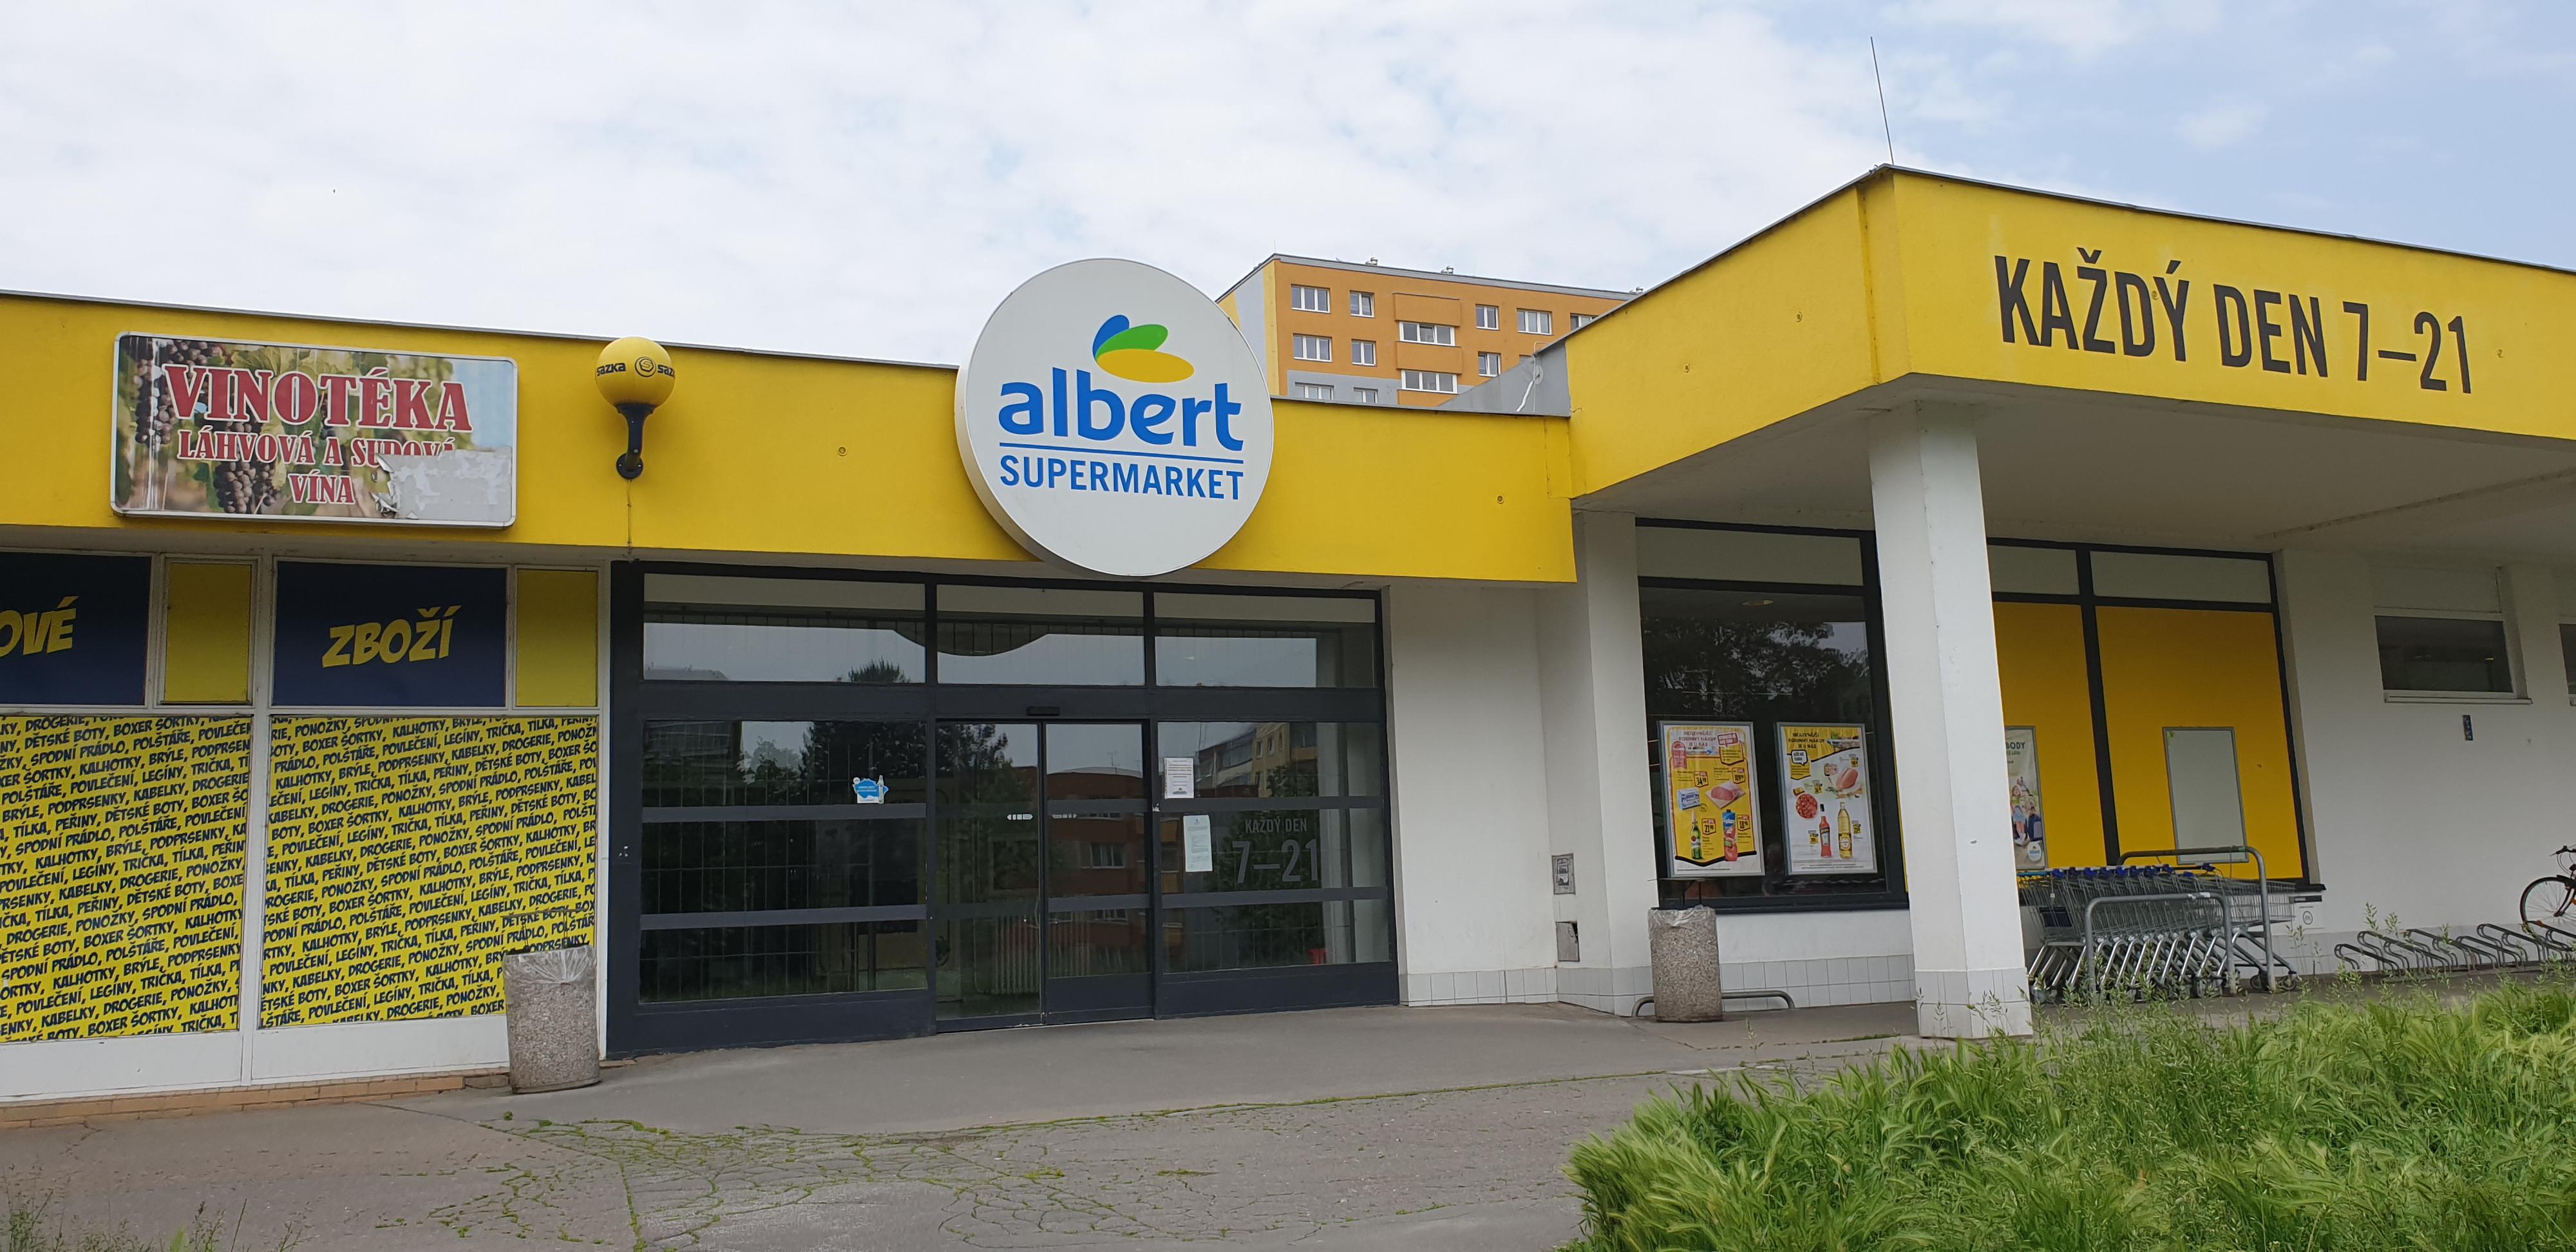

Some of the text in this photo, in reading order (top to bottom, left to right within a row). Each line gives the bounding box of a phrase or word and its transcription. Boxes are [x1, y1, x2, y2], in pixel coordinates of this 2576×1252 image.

[1994, 247, 2190, 362] KAŽDÝ
[2213, 284, 2329, 377] DEN
[162, 364, 473, 432] VINOTÉKA
[998, 367, 1244, 451] albert
[178, 425, 314, 464] LÁHVOVÁ
[323, 437, 345, 466] A
[289, 470, 356, 504] VÍNA
[1000, 455, 1244, 500] SUPERMARKET
[321, 605, 462, 668] ZBOŽÍ
[24, 719, 153, 750] DĚTSKÉ BOTY, BOXER
[30, 730, 194, 766] SPODNÍ PRÁDLO, POLŠTÁŘE,
[274, 755, 319, 773] PRÁDLO,
[323, 745, 379, 766] POLŠTÁŘE,
[382, 736, 441, 756] POVLEČENÍ,
[444, 730, 483, 746] LEGÍNY,
[486, 723, 525, 739] TRIČKA,
[1, 757, 234, 805] POLŠTÁŘE, POVLEČENÍ, LEGÍNY, TRIČKA,
[23, 748, 188, 784] ŠORTKY, KALHOTKY, BRÝLE,
[276, 733, 554, 790] KALHOTKY, BRÝLE, PODPRSENKY, KABELKY, DROGERIE,
[309, 743, 581, 801] LEGÍNY, TRIČKA, TÍLKA, PEŘINY, DĚTSKÉ BOTY, BOXER
[2, 804, 44, 823] BRÝLE,
[48, 792, 130, 815] PODPRSENKY,
[133, 782, 189, 802] KABELKY,
[13, 792, 229, 839] TÍLKA, PEŘINY, DĚTSKÉ BOTY, BOXER
[272, 779, 563, 841] BOTY, BOXER ŠORTKY, KALHOTKY, BRÝLE, PODPRSENKY,
[282, 792, 580, 855] POVLEČENÍ, LEGÍNY, TRIČKA, TÍLKA, PEŘINY, DĚTSKÉ BOTY,
[1245, 816, 1307, 833] KAŽDÝ DEN
[15, 817, 181, 856] SPODNÍ PRÁDLO, POLŠTÁŘE,
[35, 826, 229, 869] KALHOTKY, BRÝLE, PODPRSENKY,
[284, 823, 580, 889] TÍLKA, PEŘINY, DĚTSKÉ BOTY, BOXER ŠORTKY, KALHOTKY,
[59, 868, 182, 901] KABELKY, DROGERIE,
[72, 862, 118, 881] LEGÍNY,
[122, 853, 168, 871] TRIČKA,
[172, 846, 208, 863] TÍLKA,
[292, 854, 583, 921] BOTY, BOXER ŠORTKY, KALHOTKY, BRÝLE, PODPRSENKY,
[321, 839, 582, 898] PONOŽKY, SPODNÍ PRÁDLO, POLŠTÁŘE, POVLEČENÍ,
[6, 891, 238, 945] DROGERIE, PONOŽKY, SPODNÍ PRÁDLO,
[35, 880, 209, 922] TÍLKA, PEŘINY, DĚTSKÉ BOTY,
[301, 869, 585, 936] PRÁDLO, POLŠTÁŘE, POVLEČENÍ, LEGÍNY, TRIČKA, TÍLKA,
[1, 925, 239, 981] SPODNÍ PRÁDLO, POLŠTÁŘE, POVLEČENÍ,
[43, 920, 178, 956] BOTY, BOXER ŠORTKY,
[292, 934, 504, 989] KABELKY, DROGERIE, PONOŽKY, SPODNÍ
[16, 962, 226, 1015] POVLEČENÍ, LEGÍNY, TRIČKA, TÍLKA,
[53, 957, 164, 990] KALHOTKY, BRÝLE,
[298, 955, 482, 1005] BOTY, BOXER ŠORTKY, KALHOTKY,
[308, 969, 493, 1020] POVLEČENÍ, LEGÍNY, TRIČKA, TÍLKA,
[41, 979, 231, 1029] KABELKY, DROGERIE, PONOŽKY,
[88, 1006, 182, 1036] BOXER ŠORTKY,
